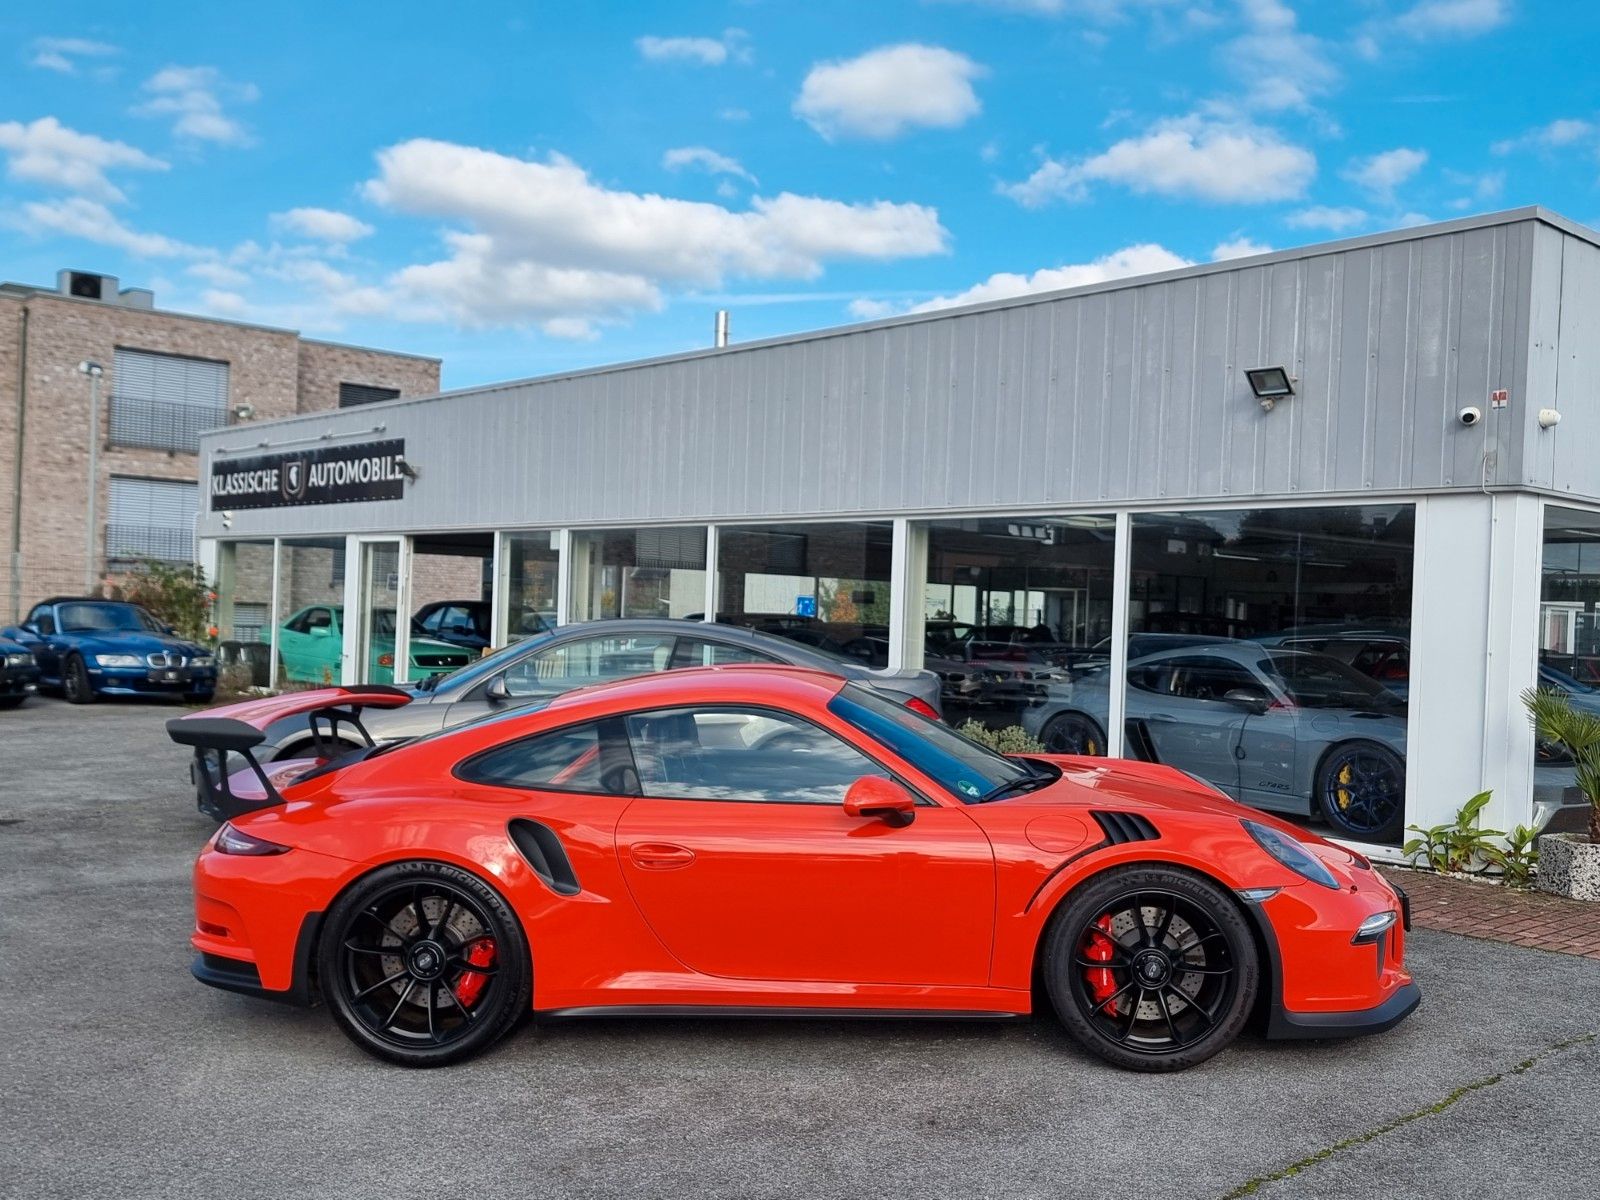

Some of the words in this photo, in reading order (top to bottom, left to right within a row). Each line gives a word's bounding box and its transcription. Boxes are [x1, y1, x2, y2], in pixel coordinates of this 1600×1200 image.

[211, 469, 279, 495] KLASSISCHE
[440, 866, 501, 908] MICHELIN
[1161, 873, 1219, 905] MICHELIN
